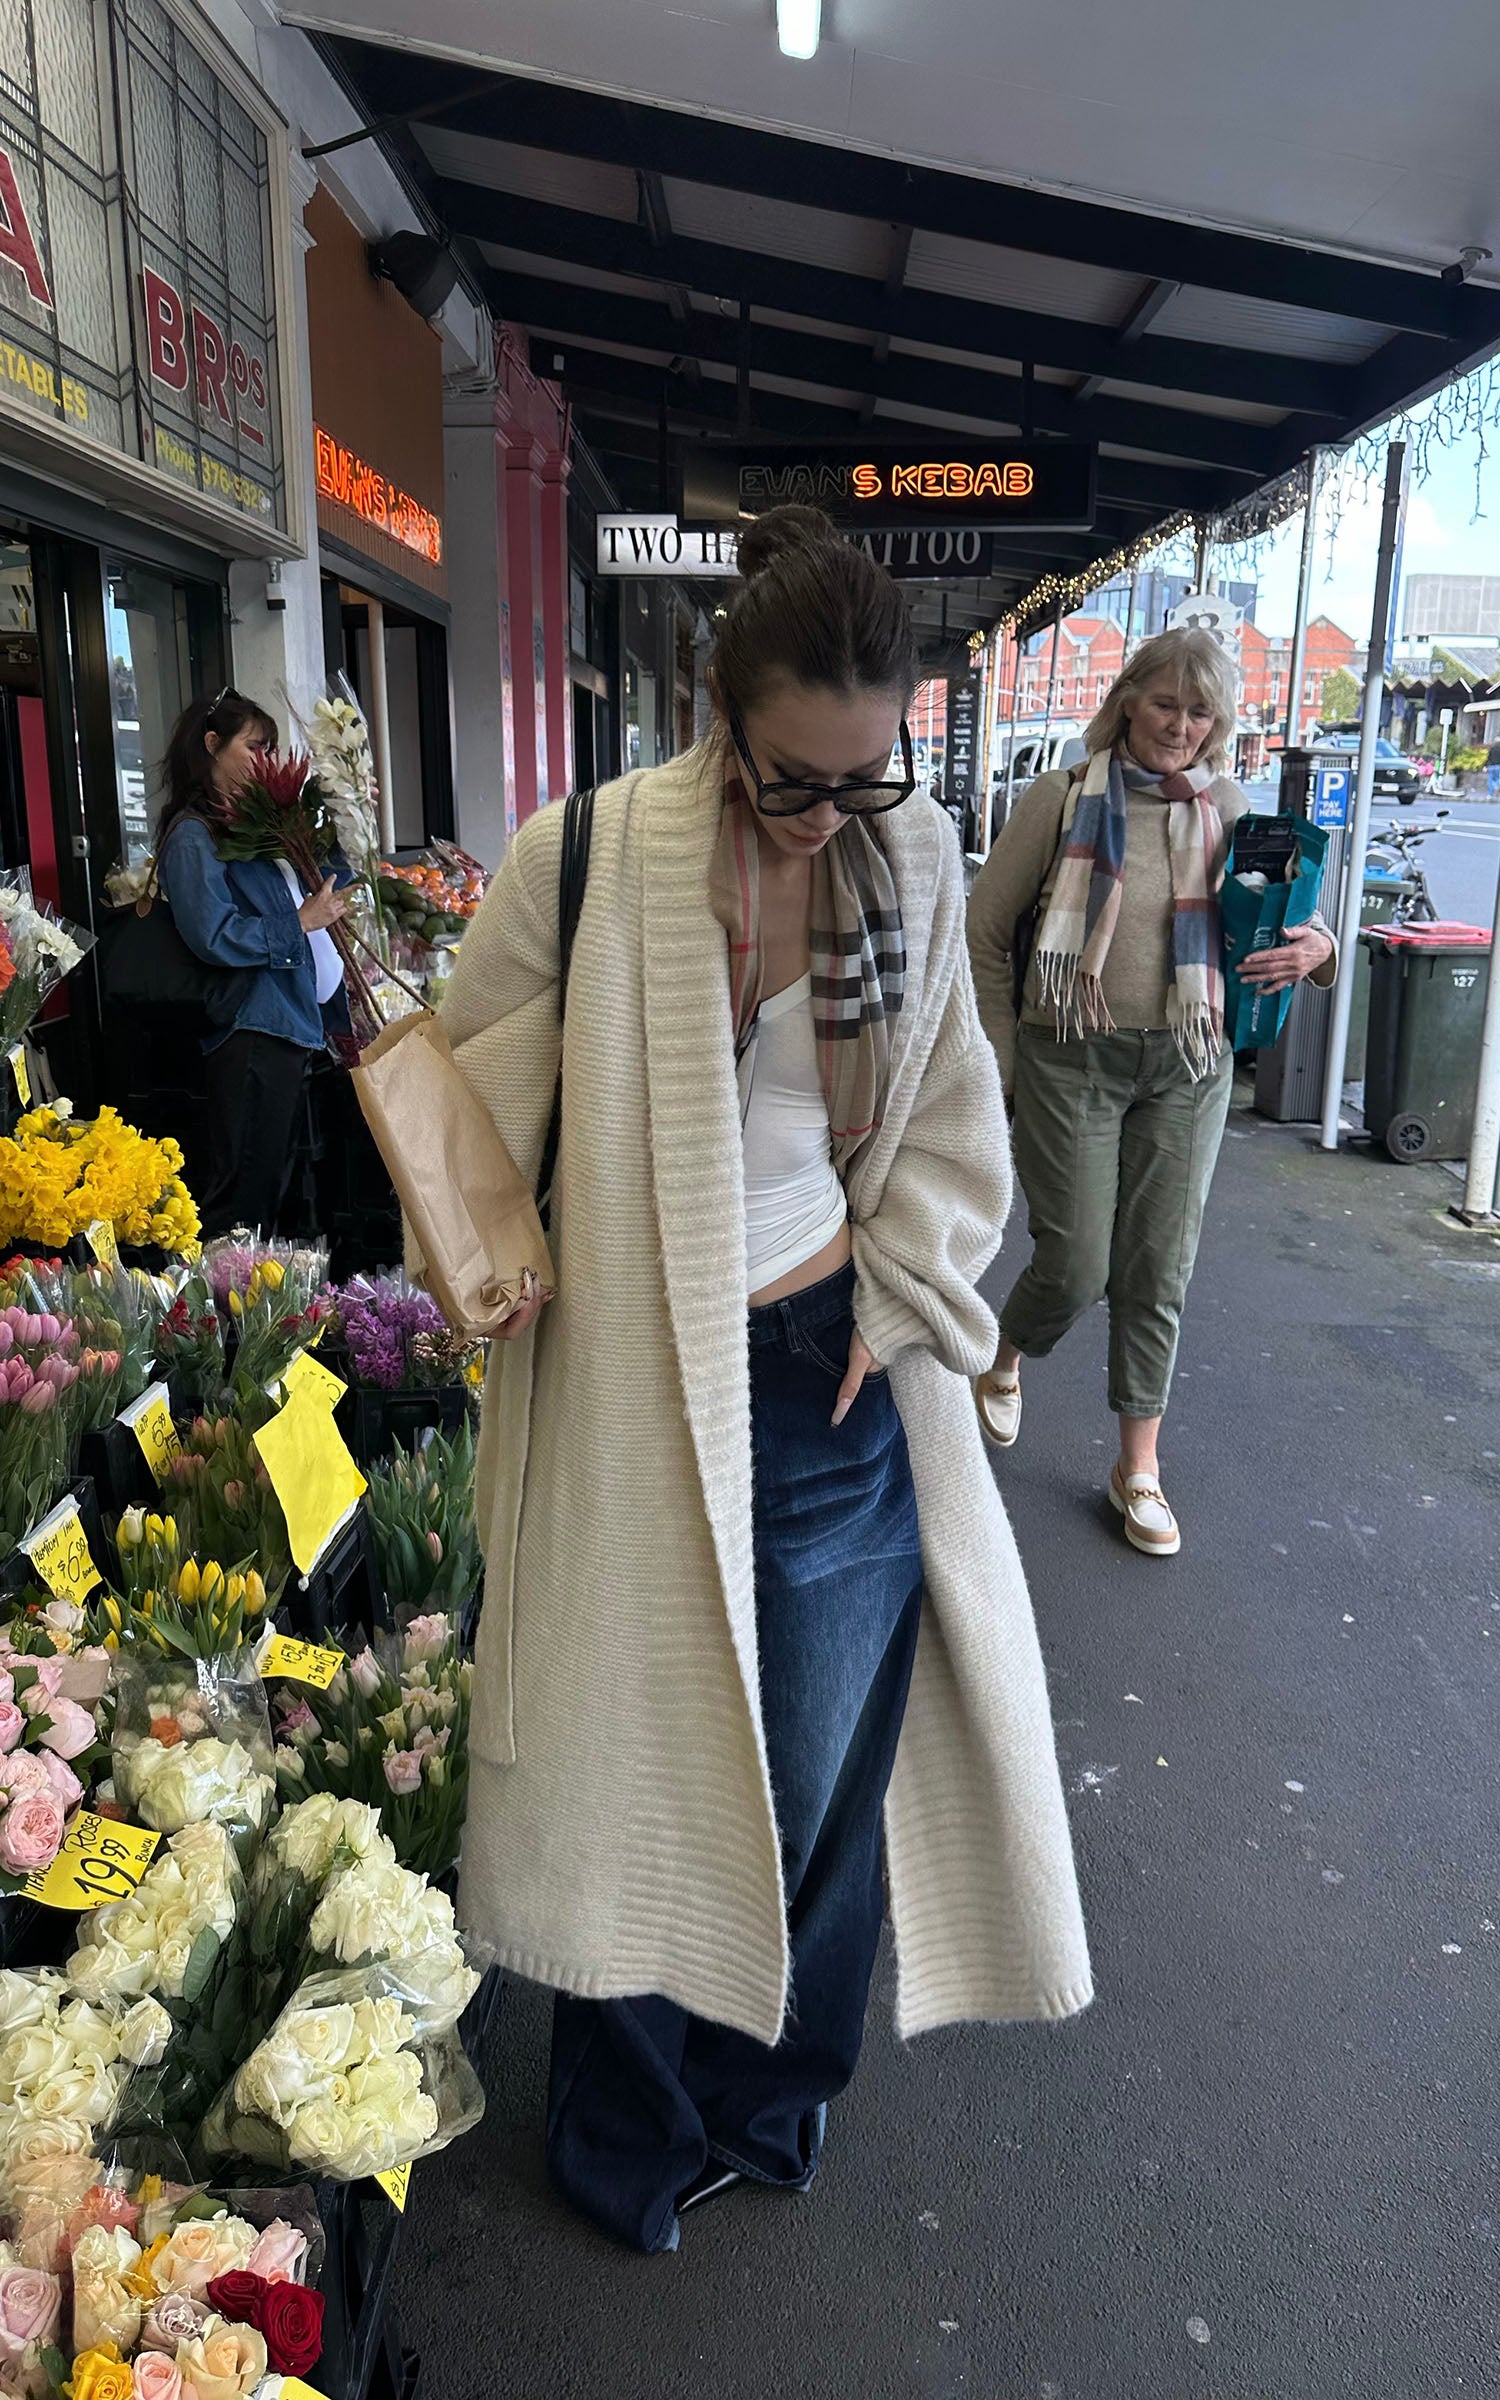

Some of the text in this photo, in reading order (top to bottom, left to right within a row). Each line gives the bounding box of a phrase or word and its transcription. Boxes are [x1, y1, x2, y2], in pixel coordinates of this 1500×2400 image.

[155, 429, 196, 476] Phone
[892, 463, 1033, 497] KEBAB
[603, 527, 682, 565] TWO
[1305, 775, 1315, 821] 151
[1322, 772, 1345, 799] P
[1453, 976, 1476, 988] 127
[62, 1815, 102, 1853] ROSES
[135, 1837, 156, 1863] BUNCH
